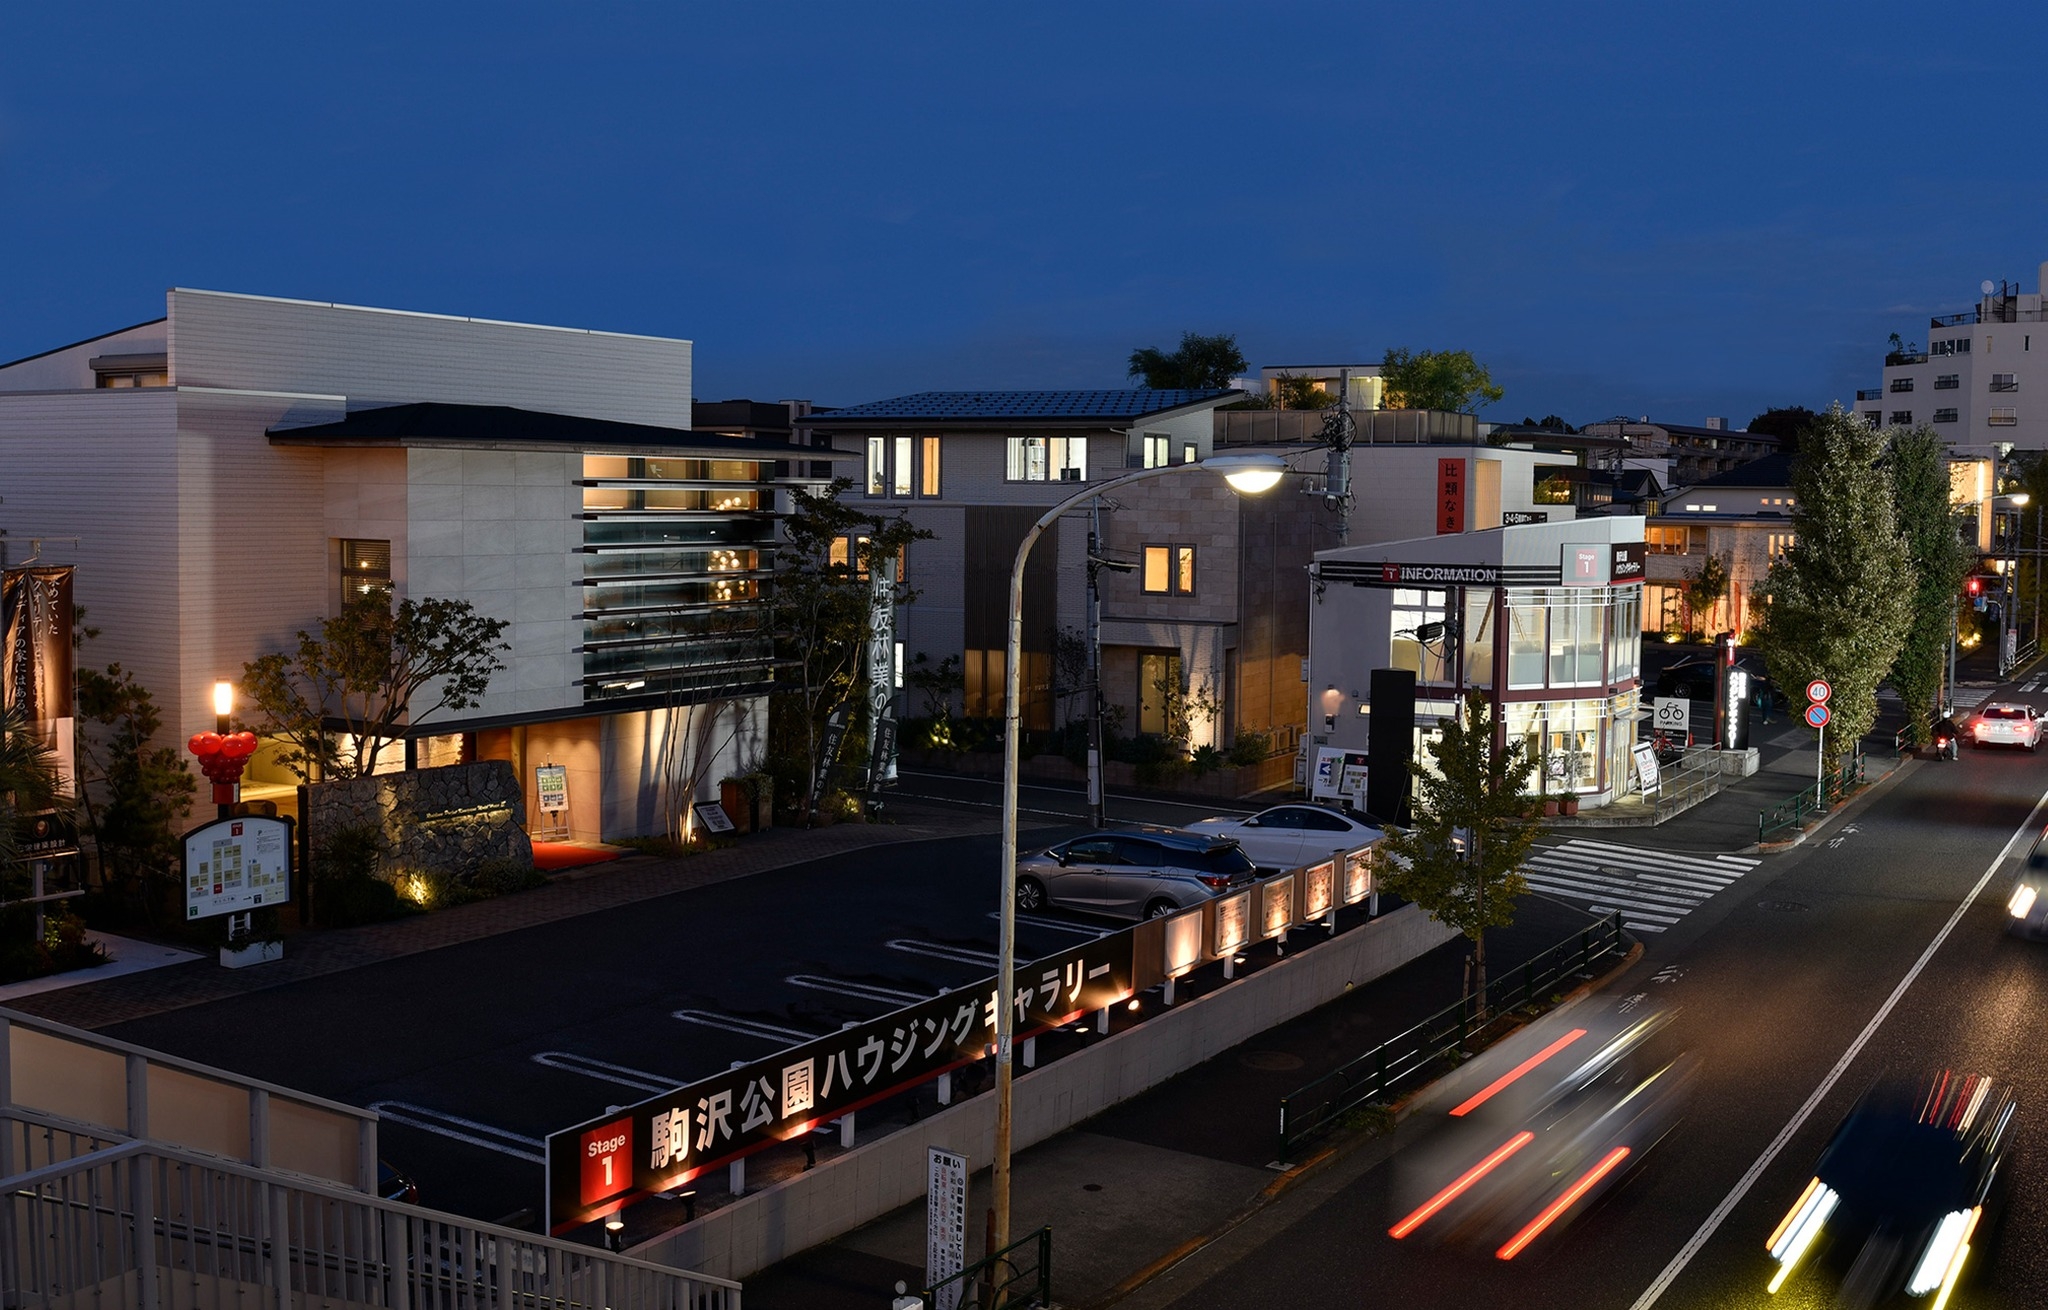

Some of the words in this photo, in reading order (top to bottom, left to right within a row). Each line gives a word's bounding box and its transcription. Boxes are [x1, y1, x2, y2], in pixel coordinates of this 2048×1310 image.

[1445, 463, 1458, 529] 比類なき
[1579, 553, 1595, 561] Stage
[1401, 567, 1496, 581] INFORMATION
[1584, 561, 1589, 573] 1
[872, 577, 889, 741] 住友林業の
[1812, 687, 1826, 697] 40
[588, 1133, 626, 1157] Stage
[934, 1154, 961, 1168] お願い
[602, 1156, 613, 1186] 1
